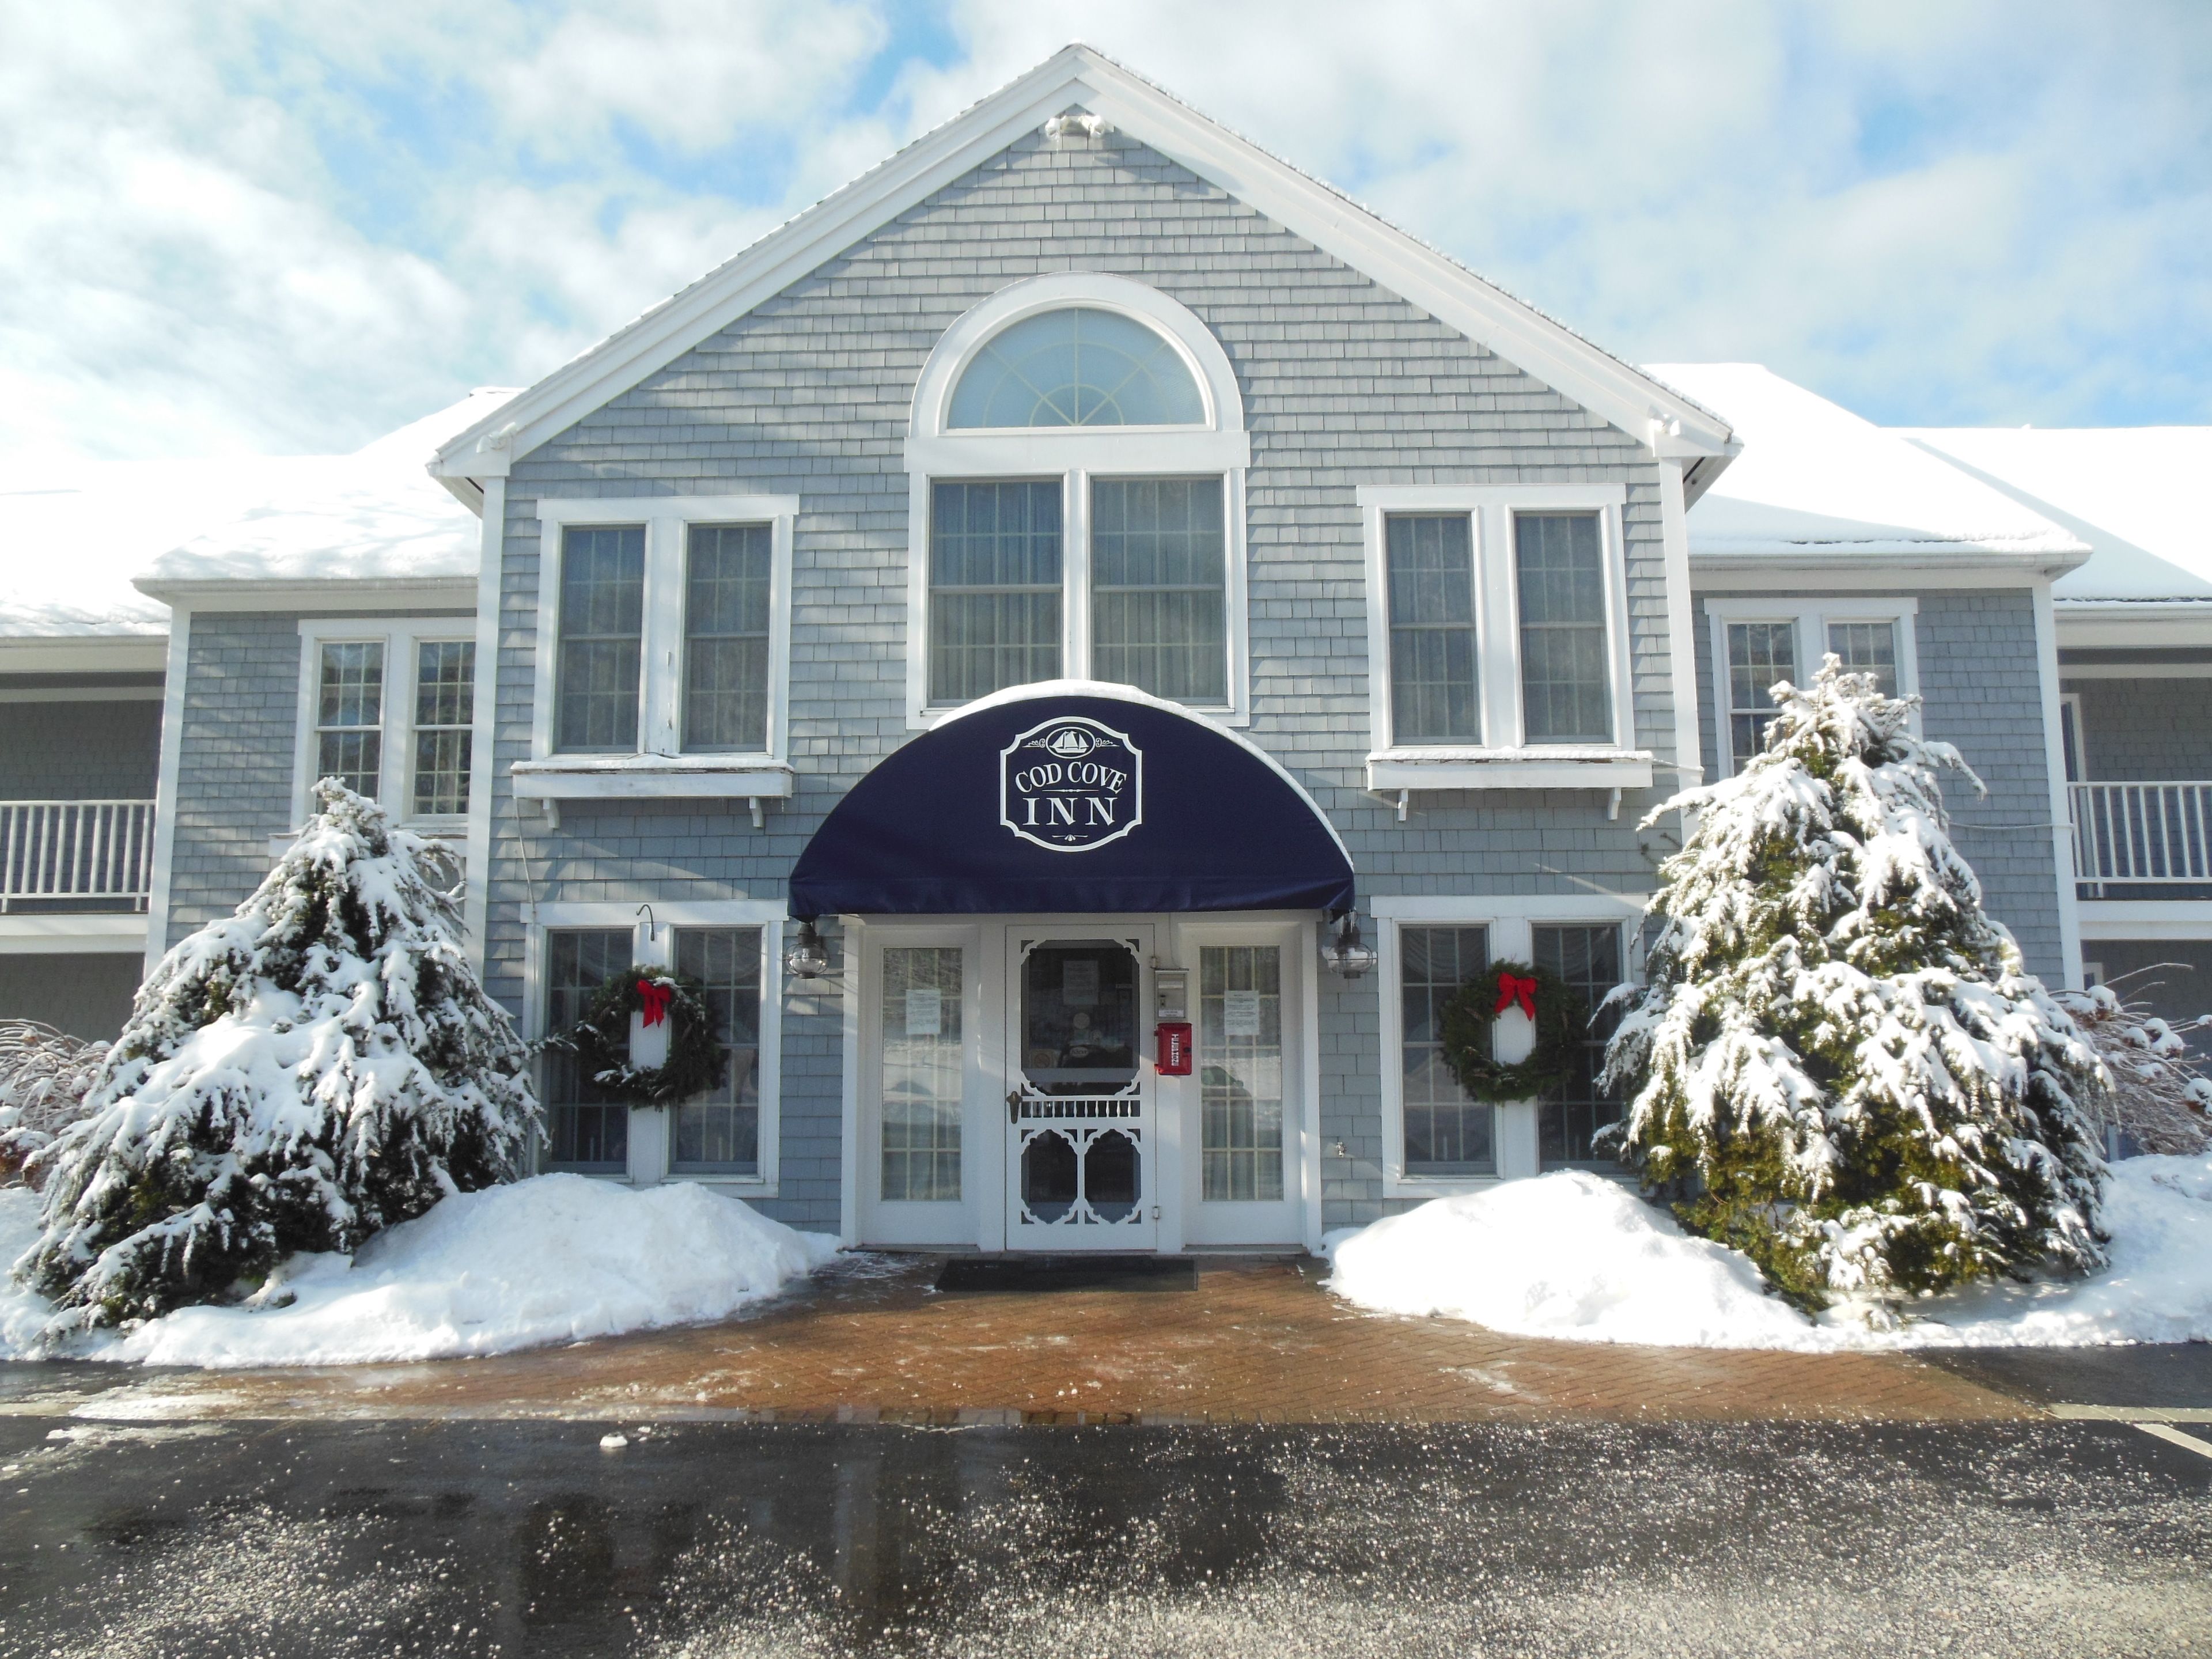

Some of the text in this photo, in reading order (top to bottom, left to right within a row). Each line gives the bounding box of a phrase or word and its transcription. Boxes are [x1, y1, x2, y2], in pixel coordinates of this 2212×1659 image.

[1015, 762, 1127, 794] COD COVE
[1022, 797, 1118, 825] INN
